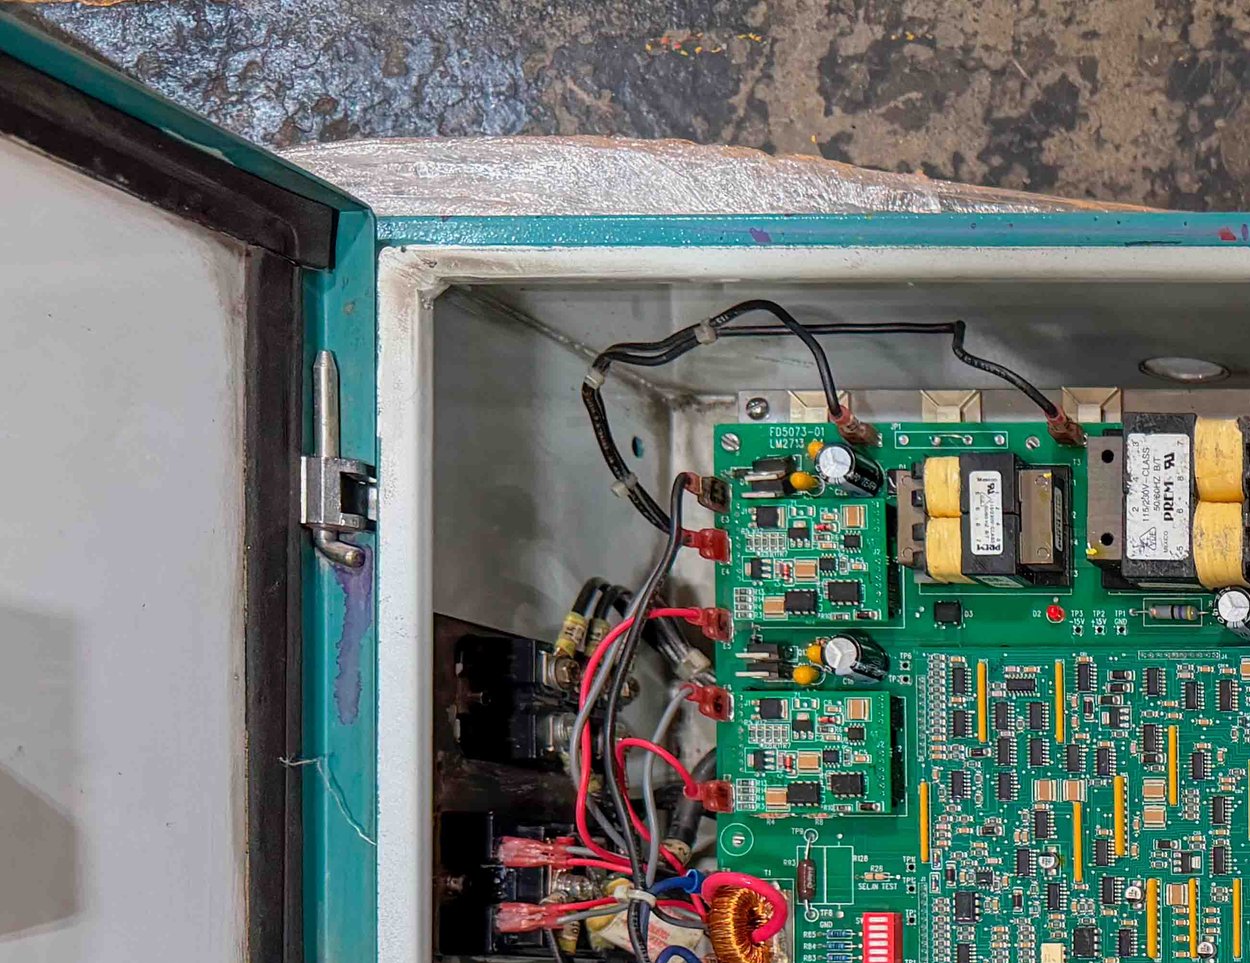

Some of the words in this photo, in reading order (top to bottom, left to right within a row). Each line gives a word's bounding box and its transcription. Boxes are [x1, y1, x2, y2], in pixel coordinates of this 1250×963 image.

[769, 426, 825, 437] FD5073-01
[1032, 610, 1042, 618] D2
[1114, 618, 1128, 626] GND
[882, 882, 898, 891] TEST
[819, 921, 833, 929] GND
